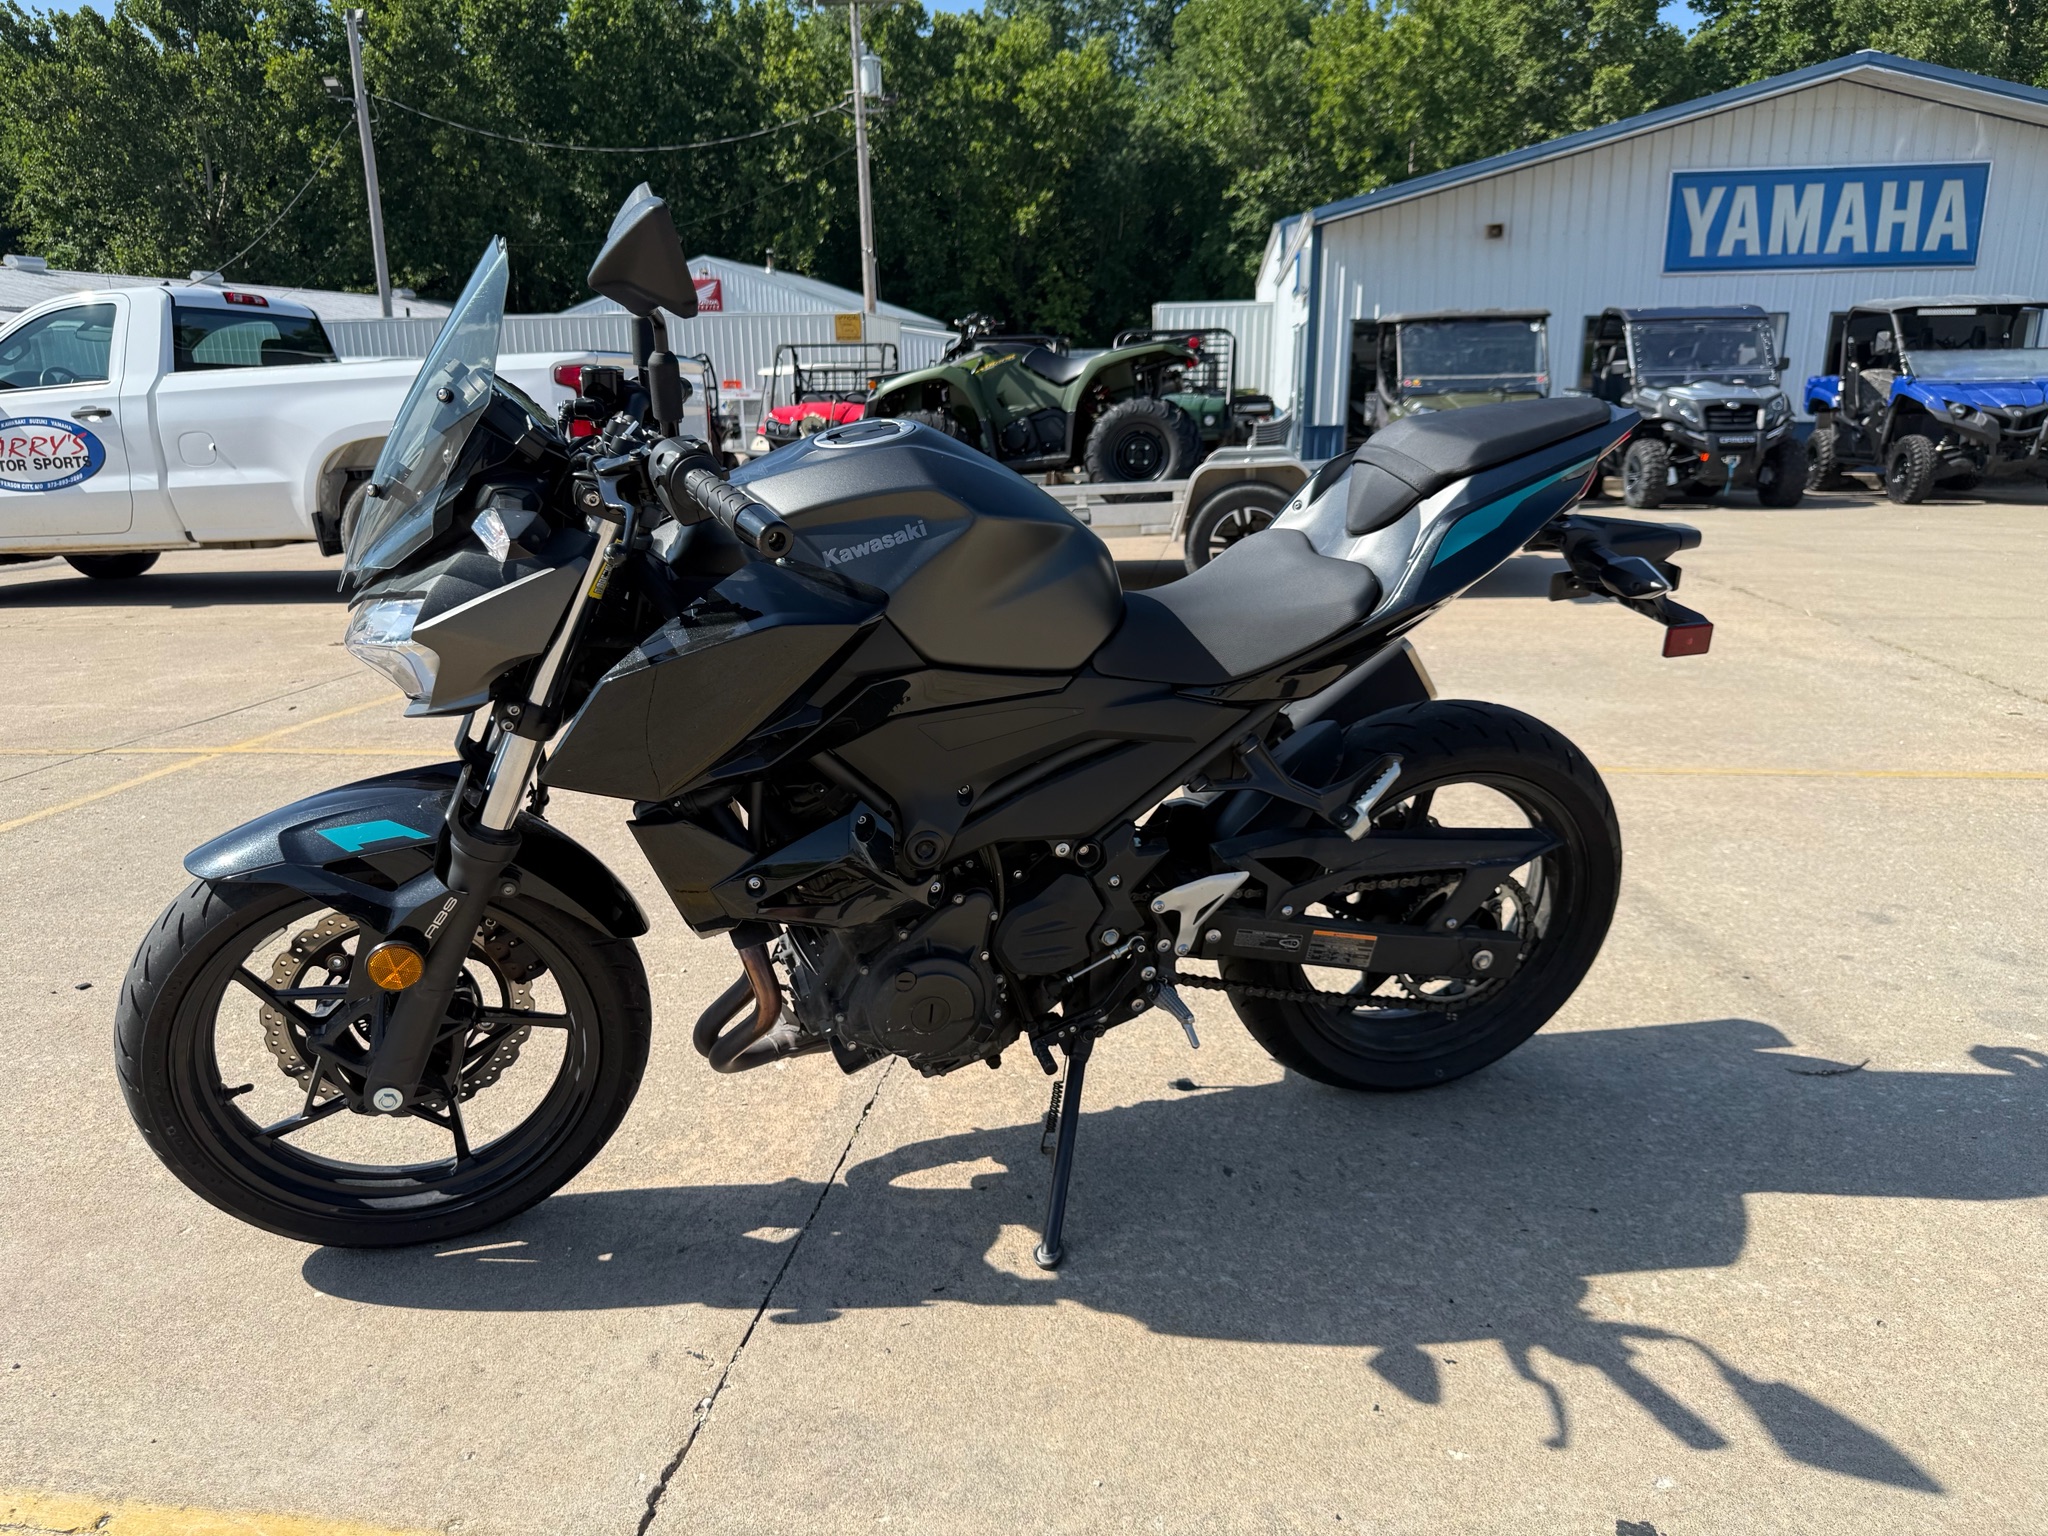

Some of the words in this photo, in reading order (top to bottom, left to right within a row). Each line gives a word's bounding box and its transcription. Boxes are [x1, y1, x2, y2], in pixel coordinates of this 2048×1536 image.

[1682, 179, 1968, 258] YAMAHA
[50, 420, 73, 432] YAMAHA
[33, 456, 92, 470] SPORTS
[822, 519, 928, 568] Kawasaki
[424, 896, 458, 939] ABS
